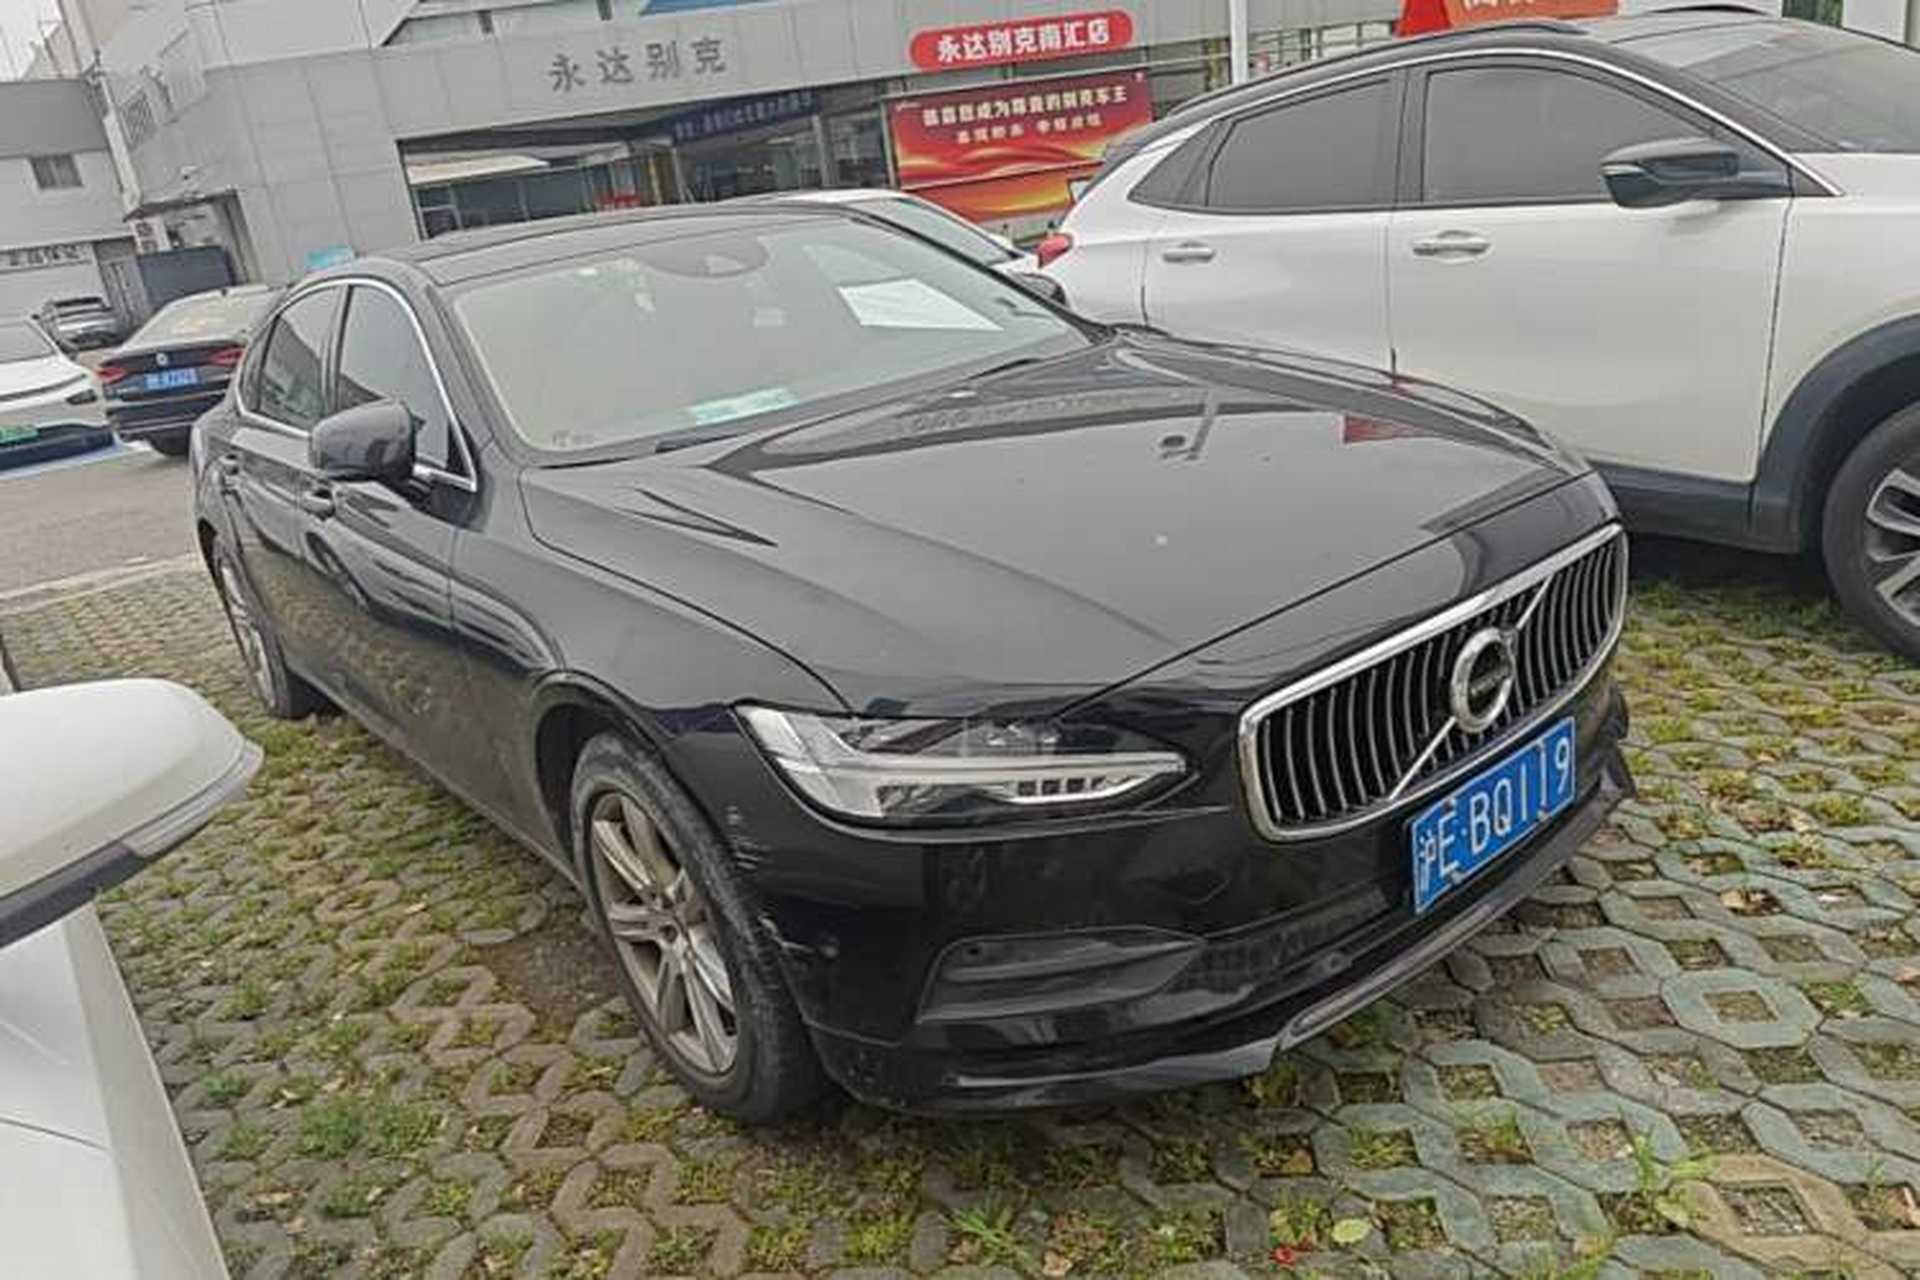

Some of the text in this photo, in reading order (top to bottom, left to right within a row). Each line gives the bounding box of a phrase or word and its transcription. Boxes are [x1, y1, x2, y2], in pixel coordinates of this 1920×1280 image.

[548, 36, 727, 92] 永达别克
[937, 18, 1111, 63] 永达别克南汇店
